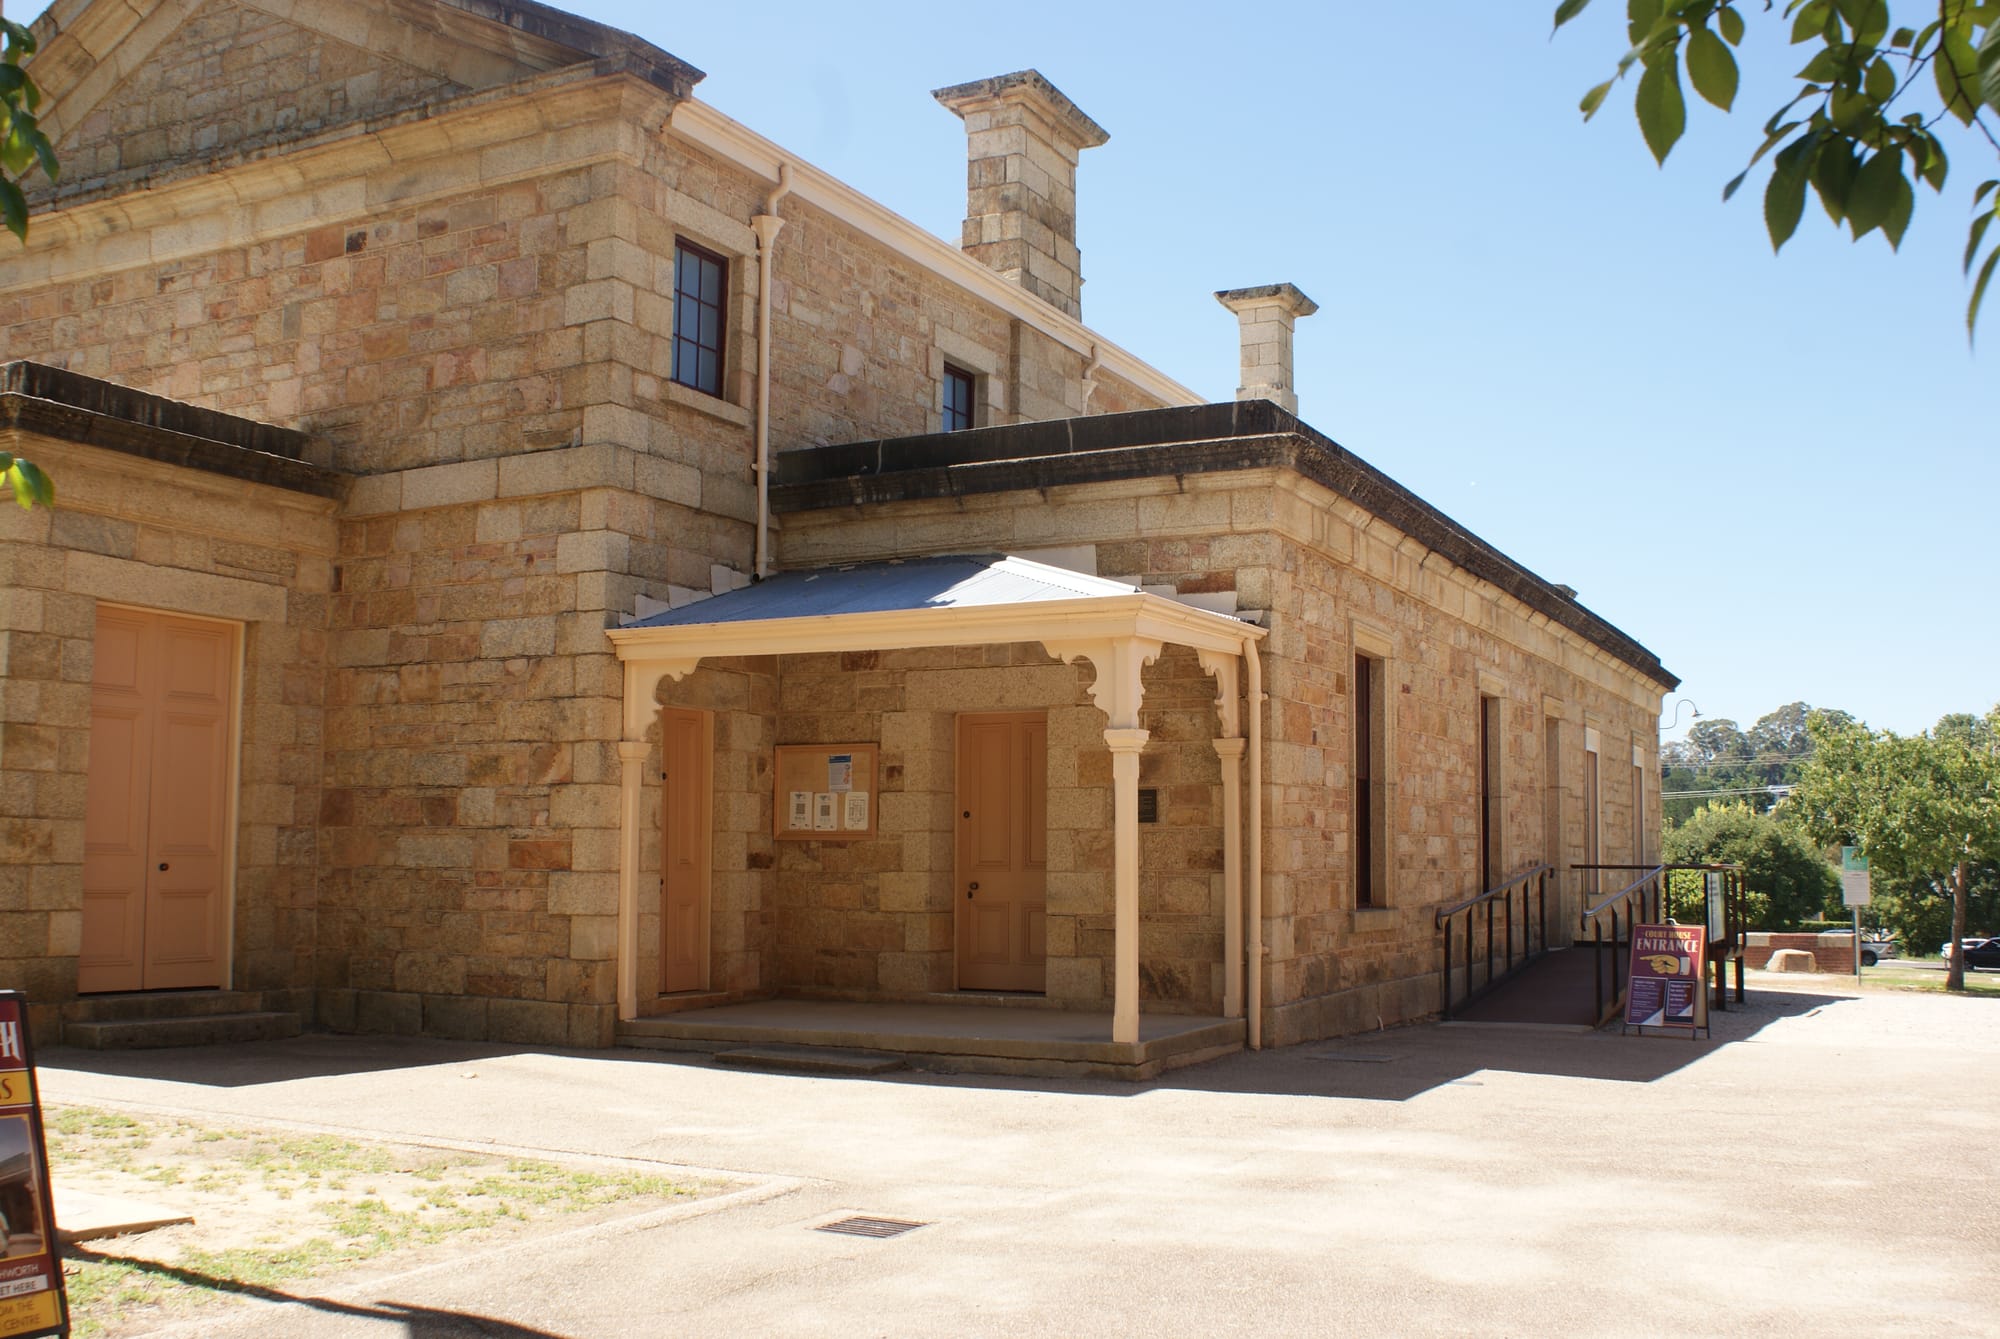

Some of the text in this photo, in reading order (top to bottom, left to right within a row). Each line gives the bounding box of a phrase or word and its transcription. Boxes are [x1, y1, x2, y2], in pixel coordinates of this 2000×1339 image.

[1645, 930, 1692, 940] COURT HOUSE
[1636, 938, 1699, 953] ENTRANCE
[13, 1280, 37, 1293] HERE
